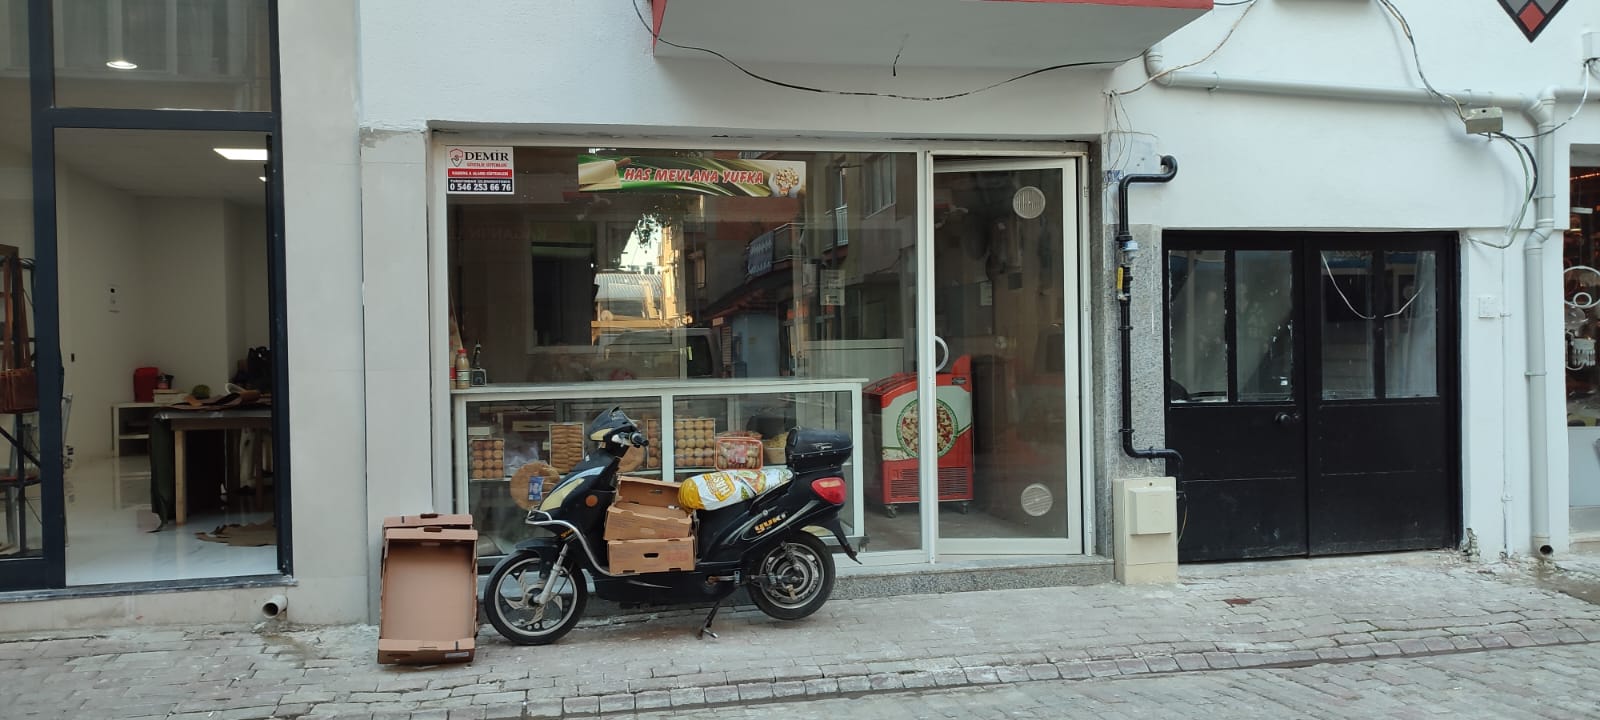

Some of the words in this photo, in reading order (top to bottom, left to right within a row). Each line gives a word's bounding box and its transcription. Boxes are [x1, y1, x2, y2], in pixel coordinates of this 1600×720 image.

[465, 150, 509, 161] DEMİR
[624, 168, 651, 182] HAS
[654, 168, 718, 183] MEVLANA
[722, 170, 764, 184] YUFKA
